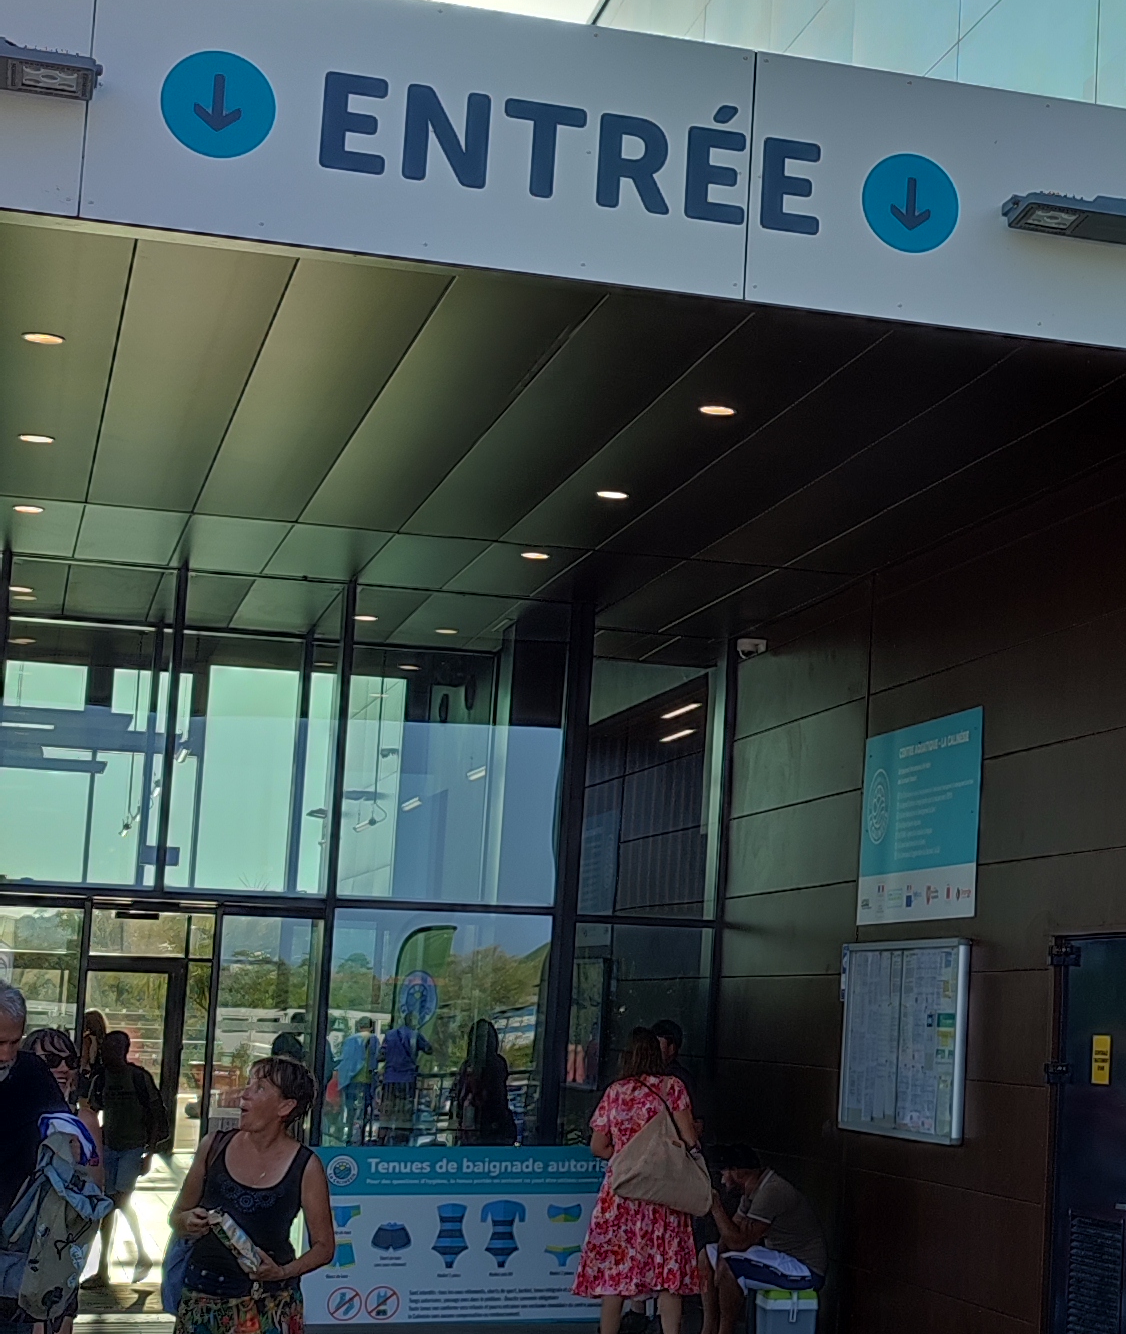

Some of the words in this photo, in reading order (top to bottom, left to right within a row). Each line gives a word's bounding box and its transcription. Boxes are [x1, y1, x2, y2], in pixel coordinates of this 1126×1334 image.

[317, 70, 822, 236] ENTRÉE
[366, 1157, 431, 1173] Tenues
[435, 1157, 457, 1173] de
[462, 1157, 543, 1176] baignade
[548, 1158, 609, 1173] autoris
